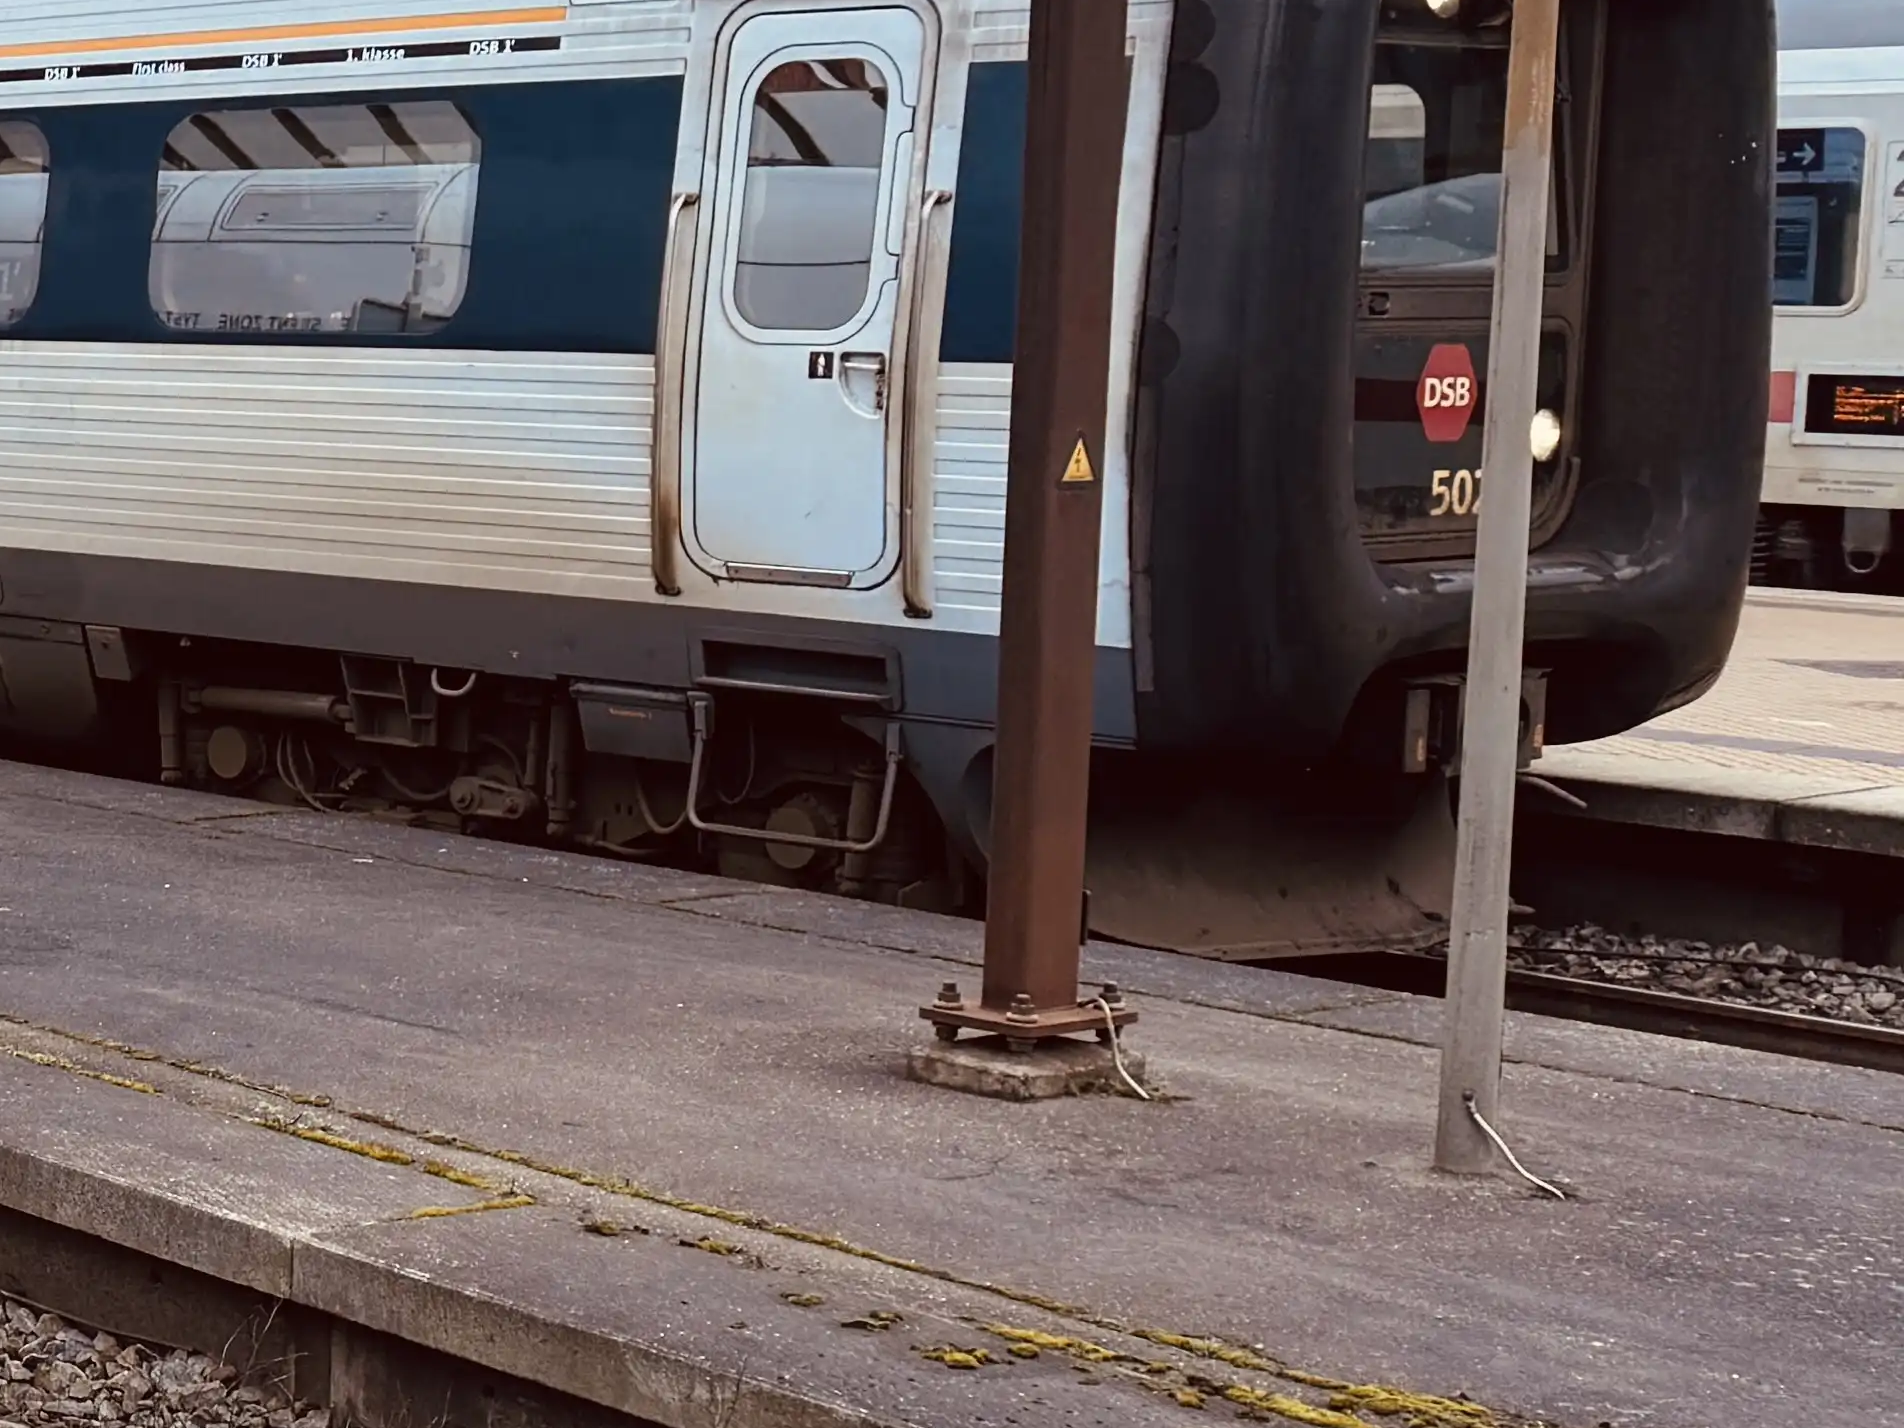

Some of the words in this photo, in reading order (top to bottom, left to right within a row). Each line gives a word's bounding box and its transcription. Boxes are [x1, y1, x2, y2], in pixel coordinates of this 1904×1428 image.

[157, 60, 186, 74] class
[361, 47, 406, 62] klasse
[469, 41, 500, 57] DSB
[1423, 377, 1471, 408] DSB
